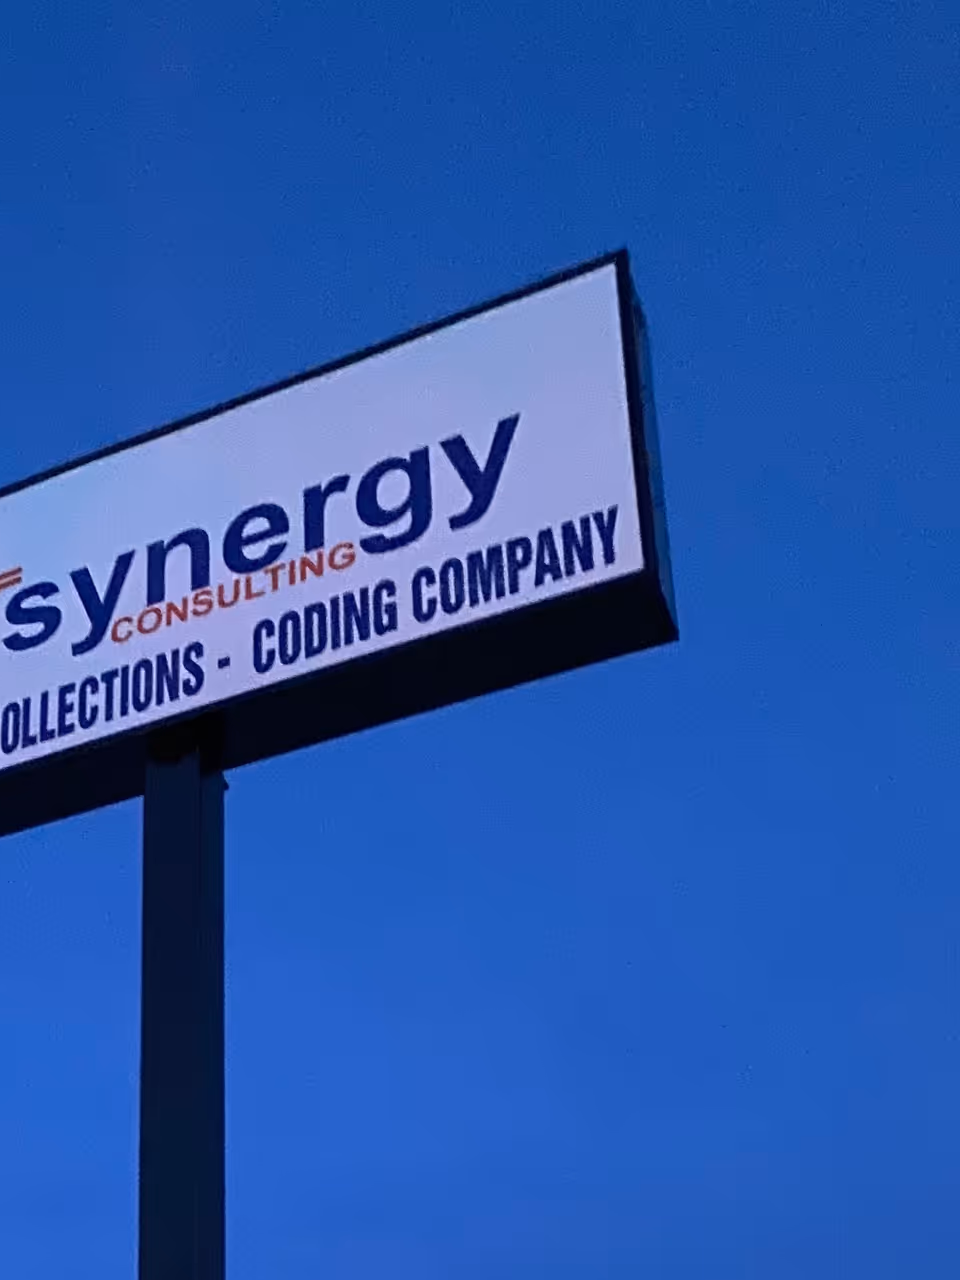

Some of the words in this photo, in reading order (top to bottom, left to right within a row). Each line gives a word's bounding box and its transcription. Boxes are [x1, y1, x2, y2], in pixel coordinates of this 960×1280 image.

[1, 412, 521, 657] synergy
[111, 541, 357, 644] CONSULTING
[252, 586, 398, 675] CODING
[411, 504, 619, 624] COMPANY
